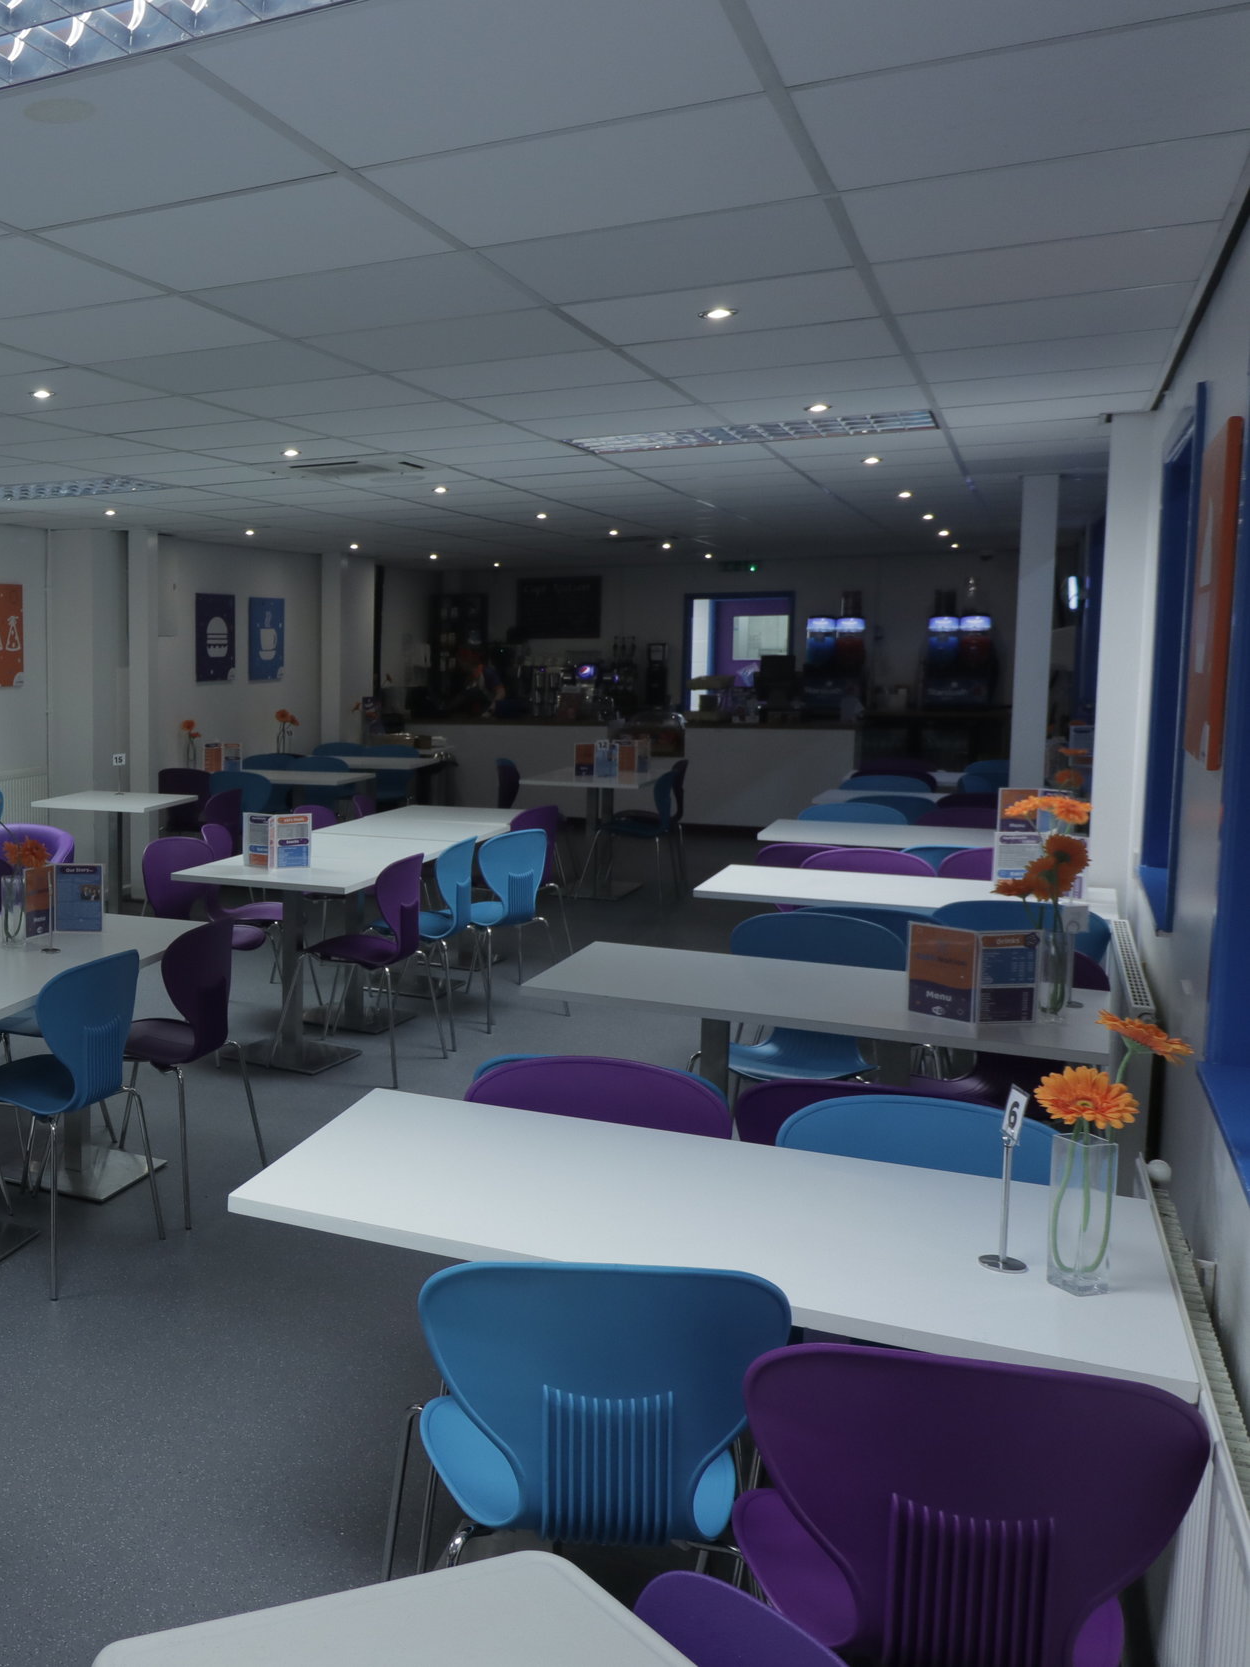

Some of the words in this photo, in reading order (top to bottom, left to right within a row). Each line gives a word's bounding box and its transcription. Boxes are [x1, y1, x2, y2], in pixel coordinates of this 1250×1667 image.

[114, 756, 123, 764] 15
[925, 990, 952, 1002] Menu
[1008, 1101, 1020, 1130] 6
